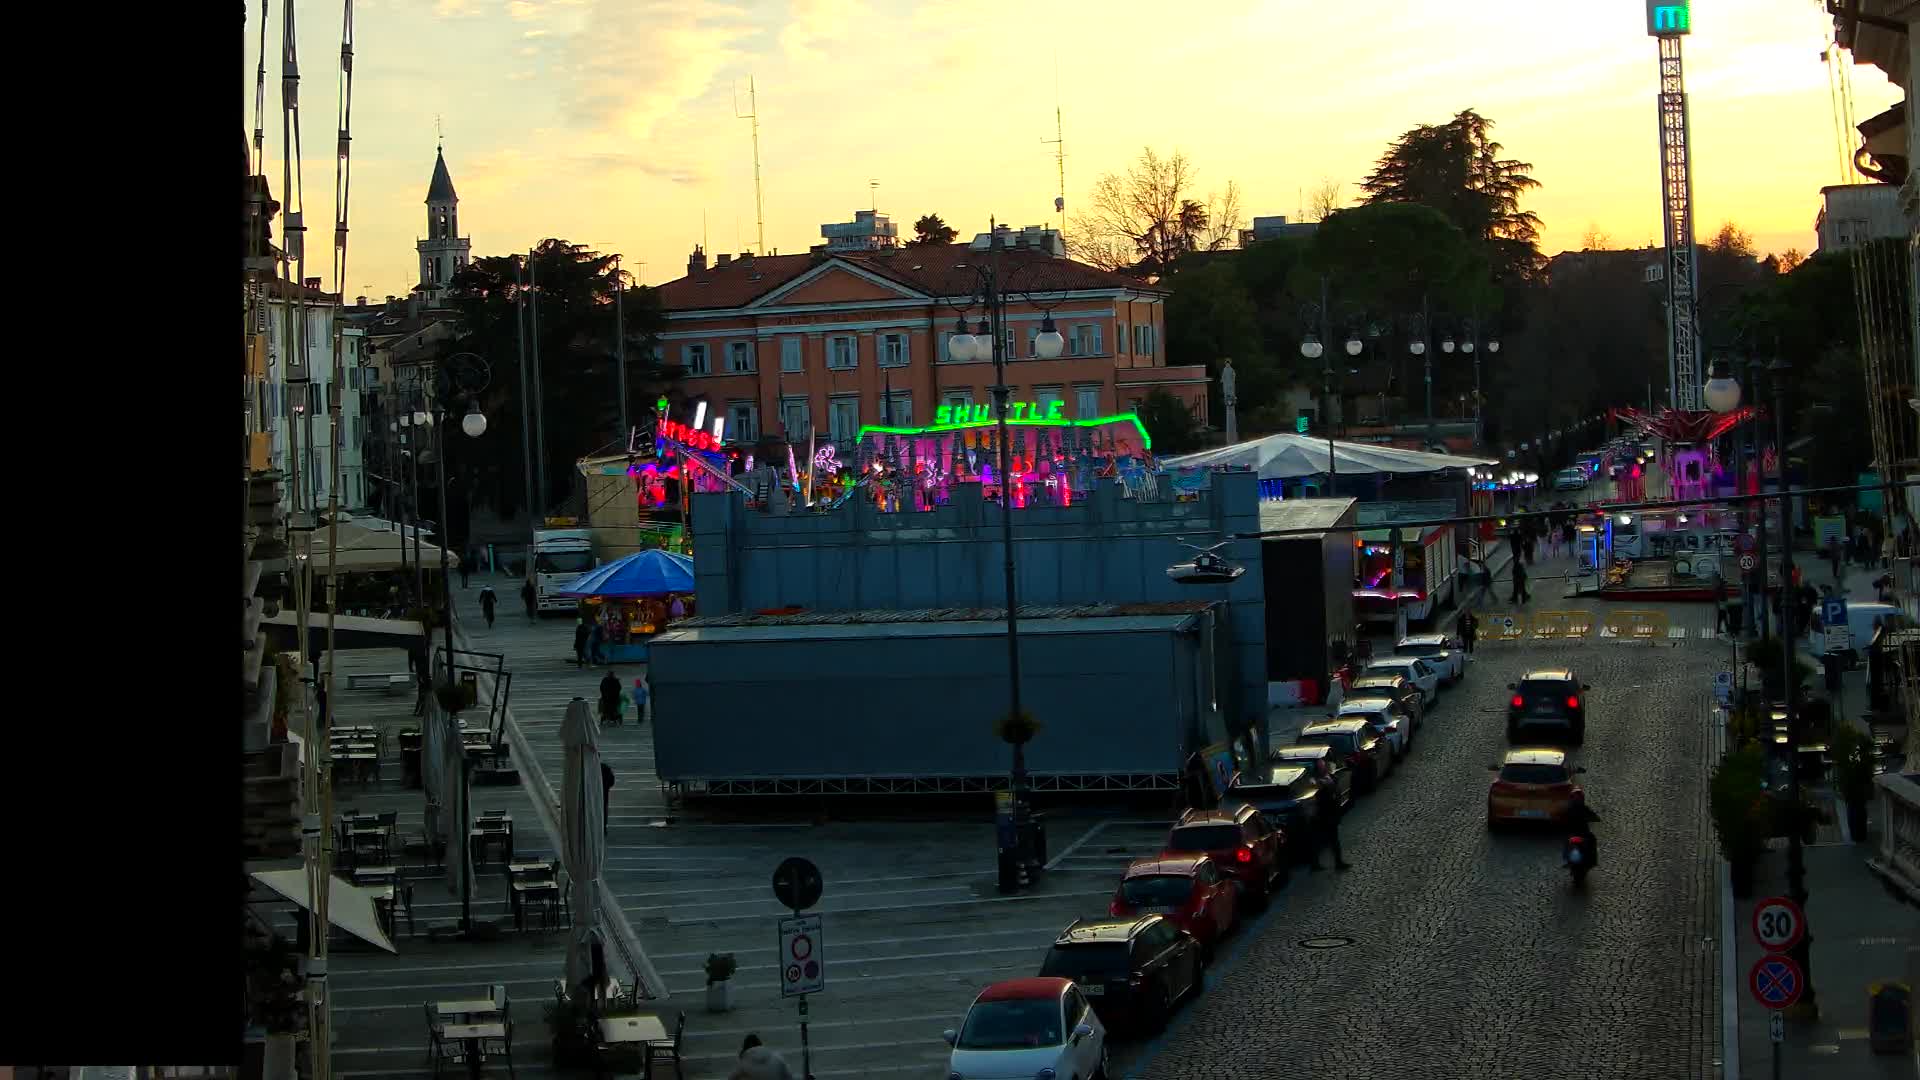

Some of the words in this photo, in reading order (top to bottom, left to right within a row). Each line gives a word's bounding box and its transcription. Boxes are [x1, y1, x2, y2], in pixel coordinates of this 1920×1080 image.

[935, 400, 1065, 424] SHUTLE
[1827, 602, 1842, 623] P
[1762, 912, 1791, 937] 30
